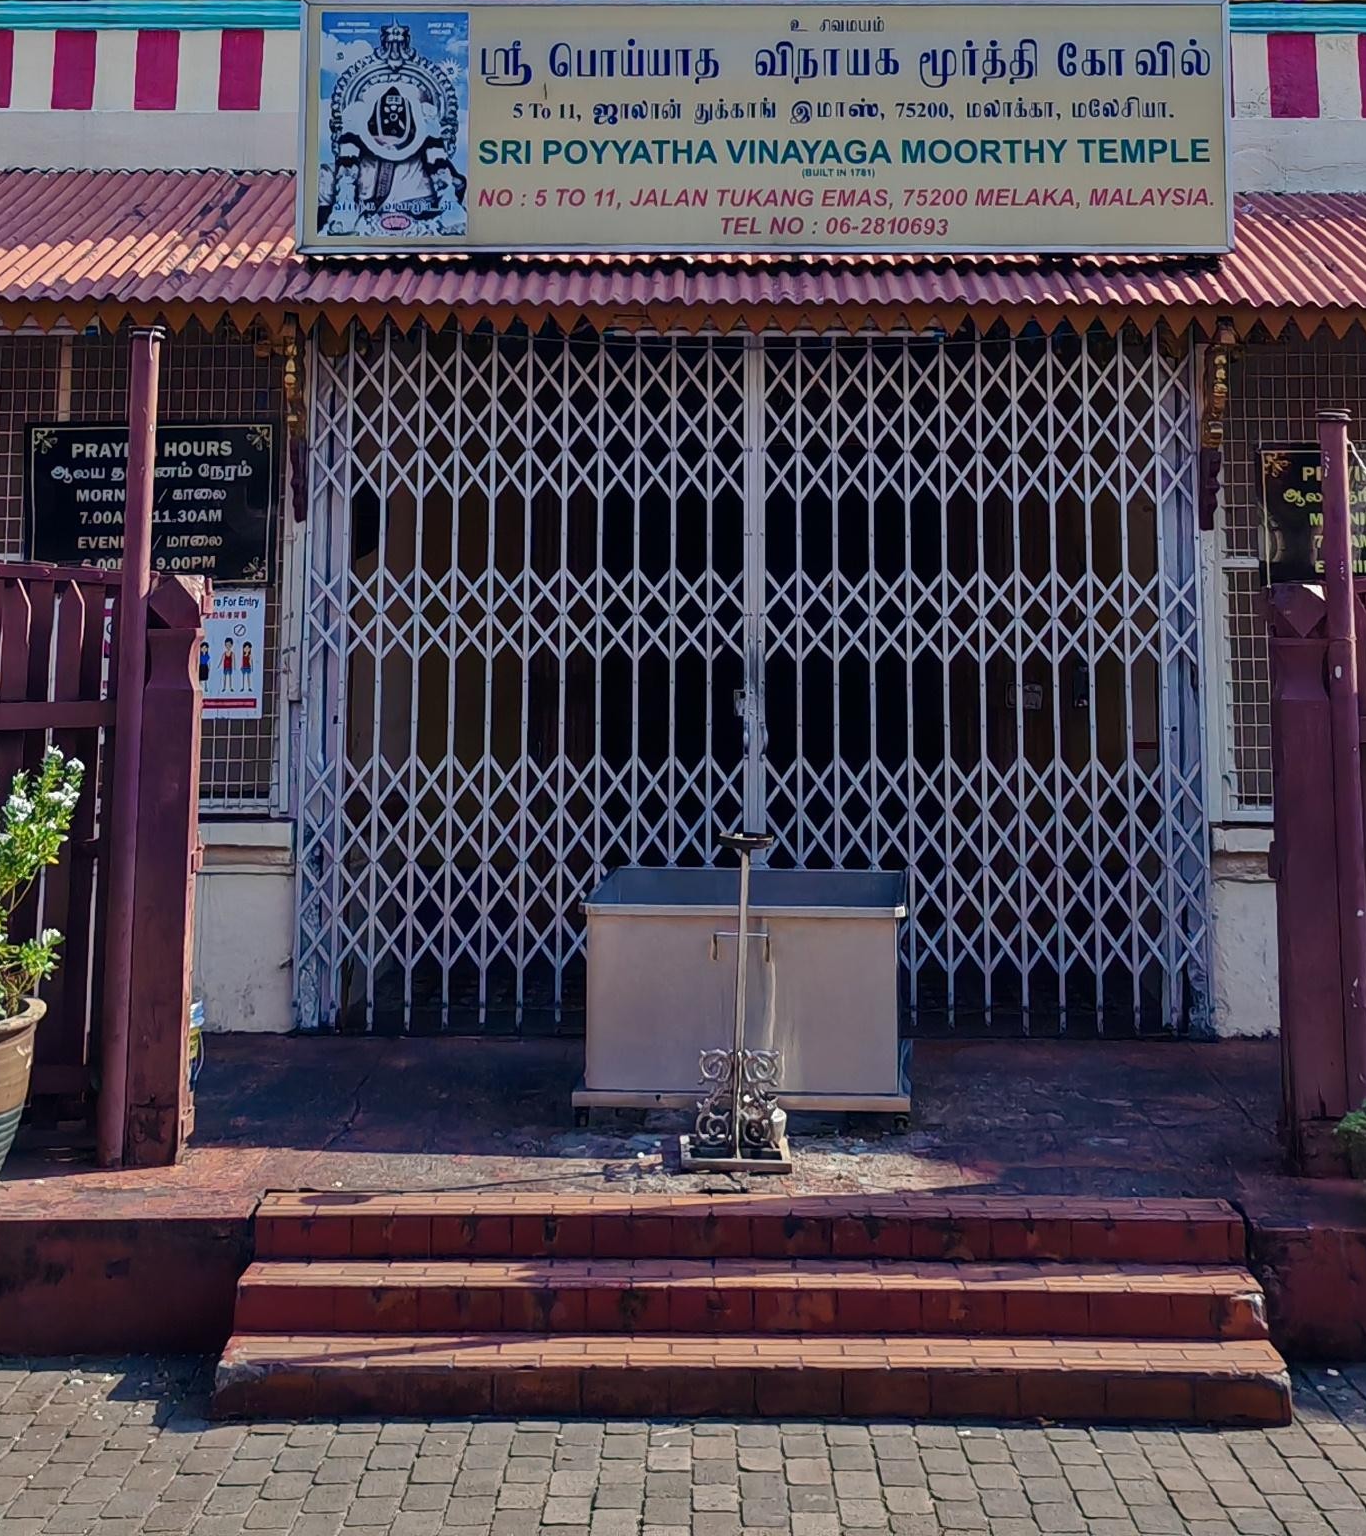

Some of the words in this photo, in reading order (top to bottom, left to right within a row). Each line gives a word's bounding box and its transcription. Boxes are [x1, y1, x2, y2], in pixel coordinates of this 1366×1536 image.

[549, 38, 720, 84] பொய்யாத
[755, 40, 900, 85] விநாயக
[919, 39, 1039, 88] மூர்த்தி
[513, 103, 523, 119] 5
[528, 103, 551, 120] To
[560, 103, 582, 123] 11,
[593, 98, 682, 125] ஜாலான்
[895, 101, 955, 121] 75200,
[478, 139, 531, 165] SRI
[543, 139, 718, 165] POYYATHA
[725, 139, 892, 165] VINAYAGA
[901, 138, 1068, 164] MOORTHY
[1077, 138, 1210, 164] TEMPLE
[801, 167, 833, 179] (BUILT
[836, 168, 847, 177] IN
[850, 168, 876, 179] 1781)
[478, 189, 513, 208] NO
[534, 189, 547, 208] 5
[555, 189, 586, 208] TO
[593, 189, 622, 211] 11,
[629, 189, 709, 208] JALAN
[716, 189, 814, 208] TUKANG
[821, 188, 894, 210] EMAS,
[903, 188, 968, 207] 75200
[975, 188, 1081, 210] MELAKA,
[1089, 188, 1215, 207] MALAYSIA.
[720, 217, 762, 235] TEL
[769, 217, 804, 235] NO
[825, 217, 949, 236] 06-2810693
[164, 441, 233, 457] HOURS
[50, 465, 106, 484] ஆலய
[198, 460, 253, 481] நேரம்
[172, 488, 227, 501] காலை
[80, 511, 126, 524] 7.00A
[152, 509, 223, 524] 11.30AM
[167, 535, 223, 548] மாலை
[156, 556, 216, 570] 9.00PM
[223, 596, 237, 607] For
[238, 596, 260, 609] Entry
